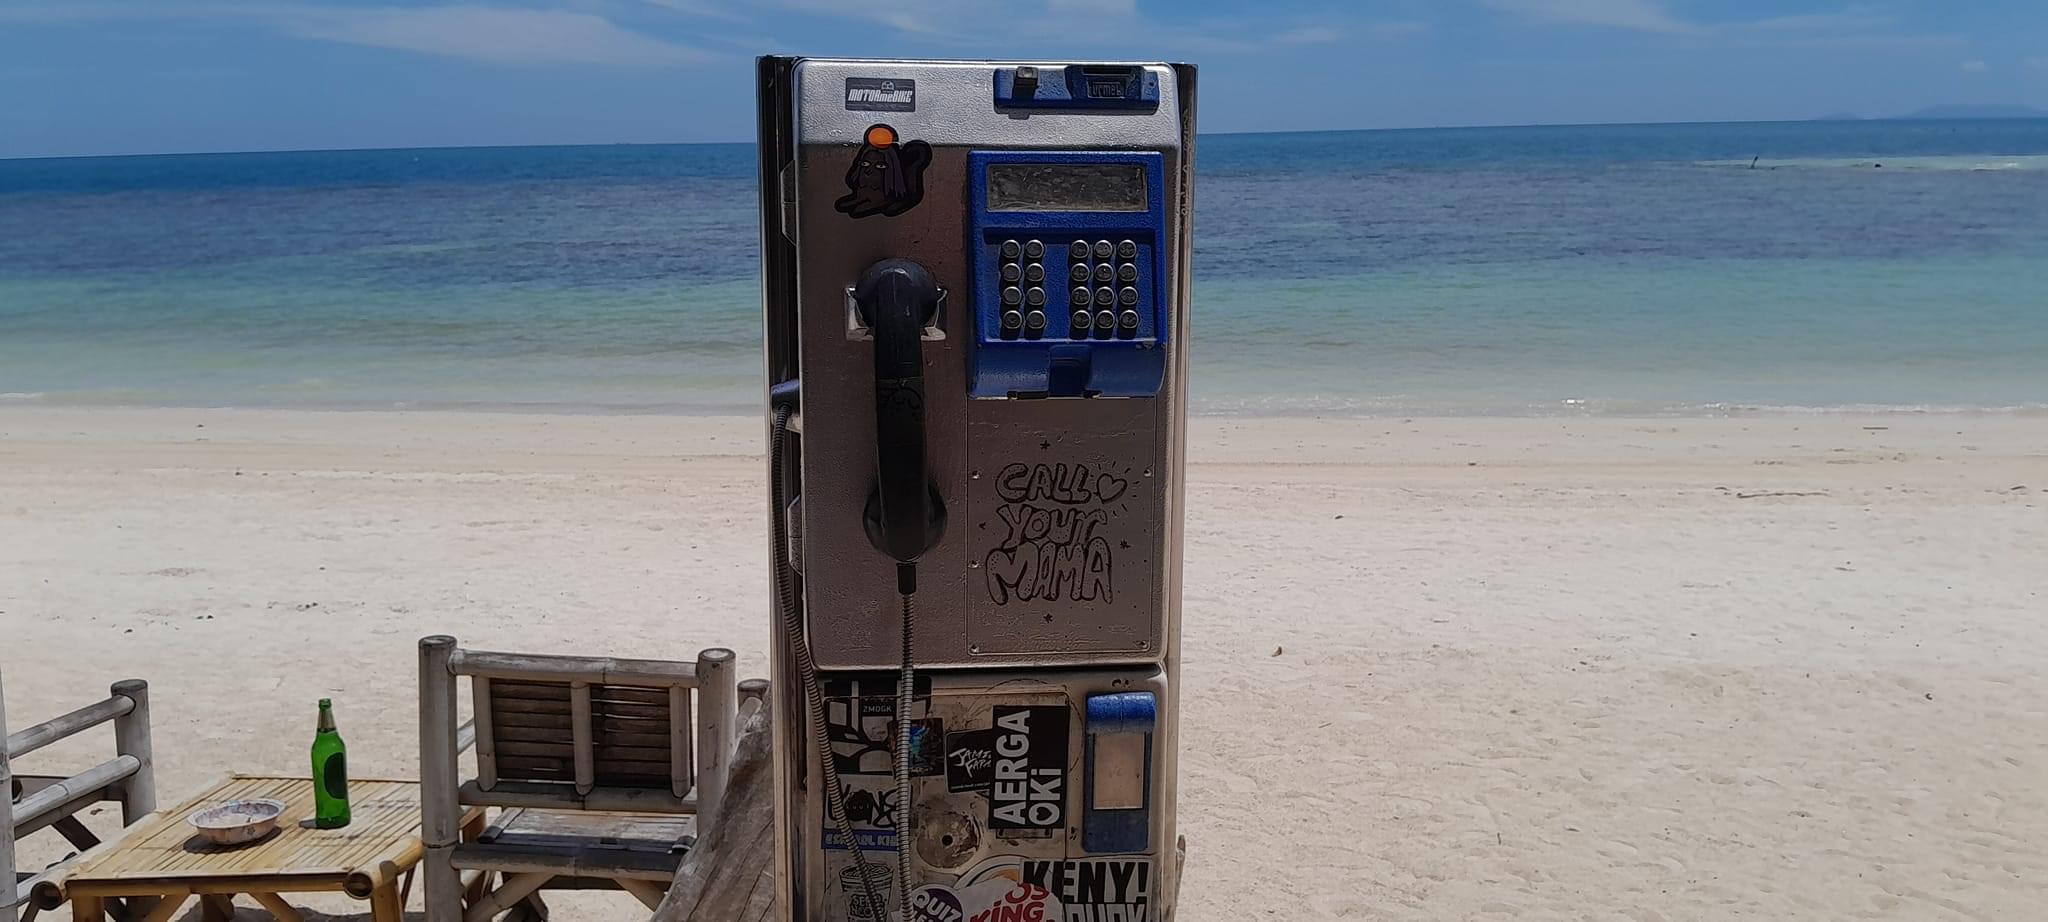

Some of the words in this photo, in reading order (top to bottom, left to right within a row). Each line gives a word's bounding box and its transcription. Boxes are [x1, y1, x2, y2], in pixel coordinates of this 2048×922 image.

[995, 462, 1092, 504] CALL
[985, 537, 1113, 606] MAMA
[993, 710, 1032, 825] AERGA
[1023, 861, 1149, 904] KENY!
[912, 889, 962, 922] QUIZ
